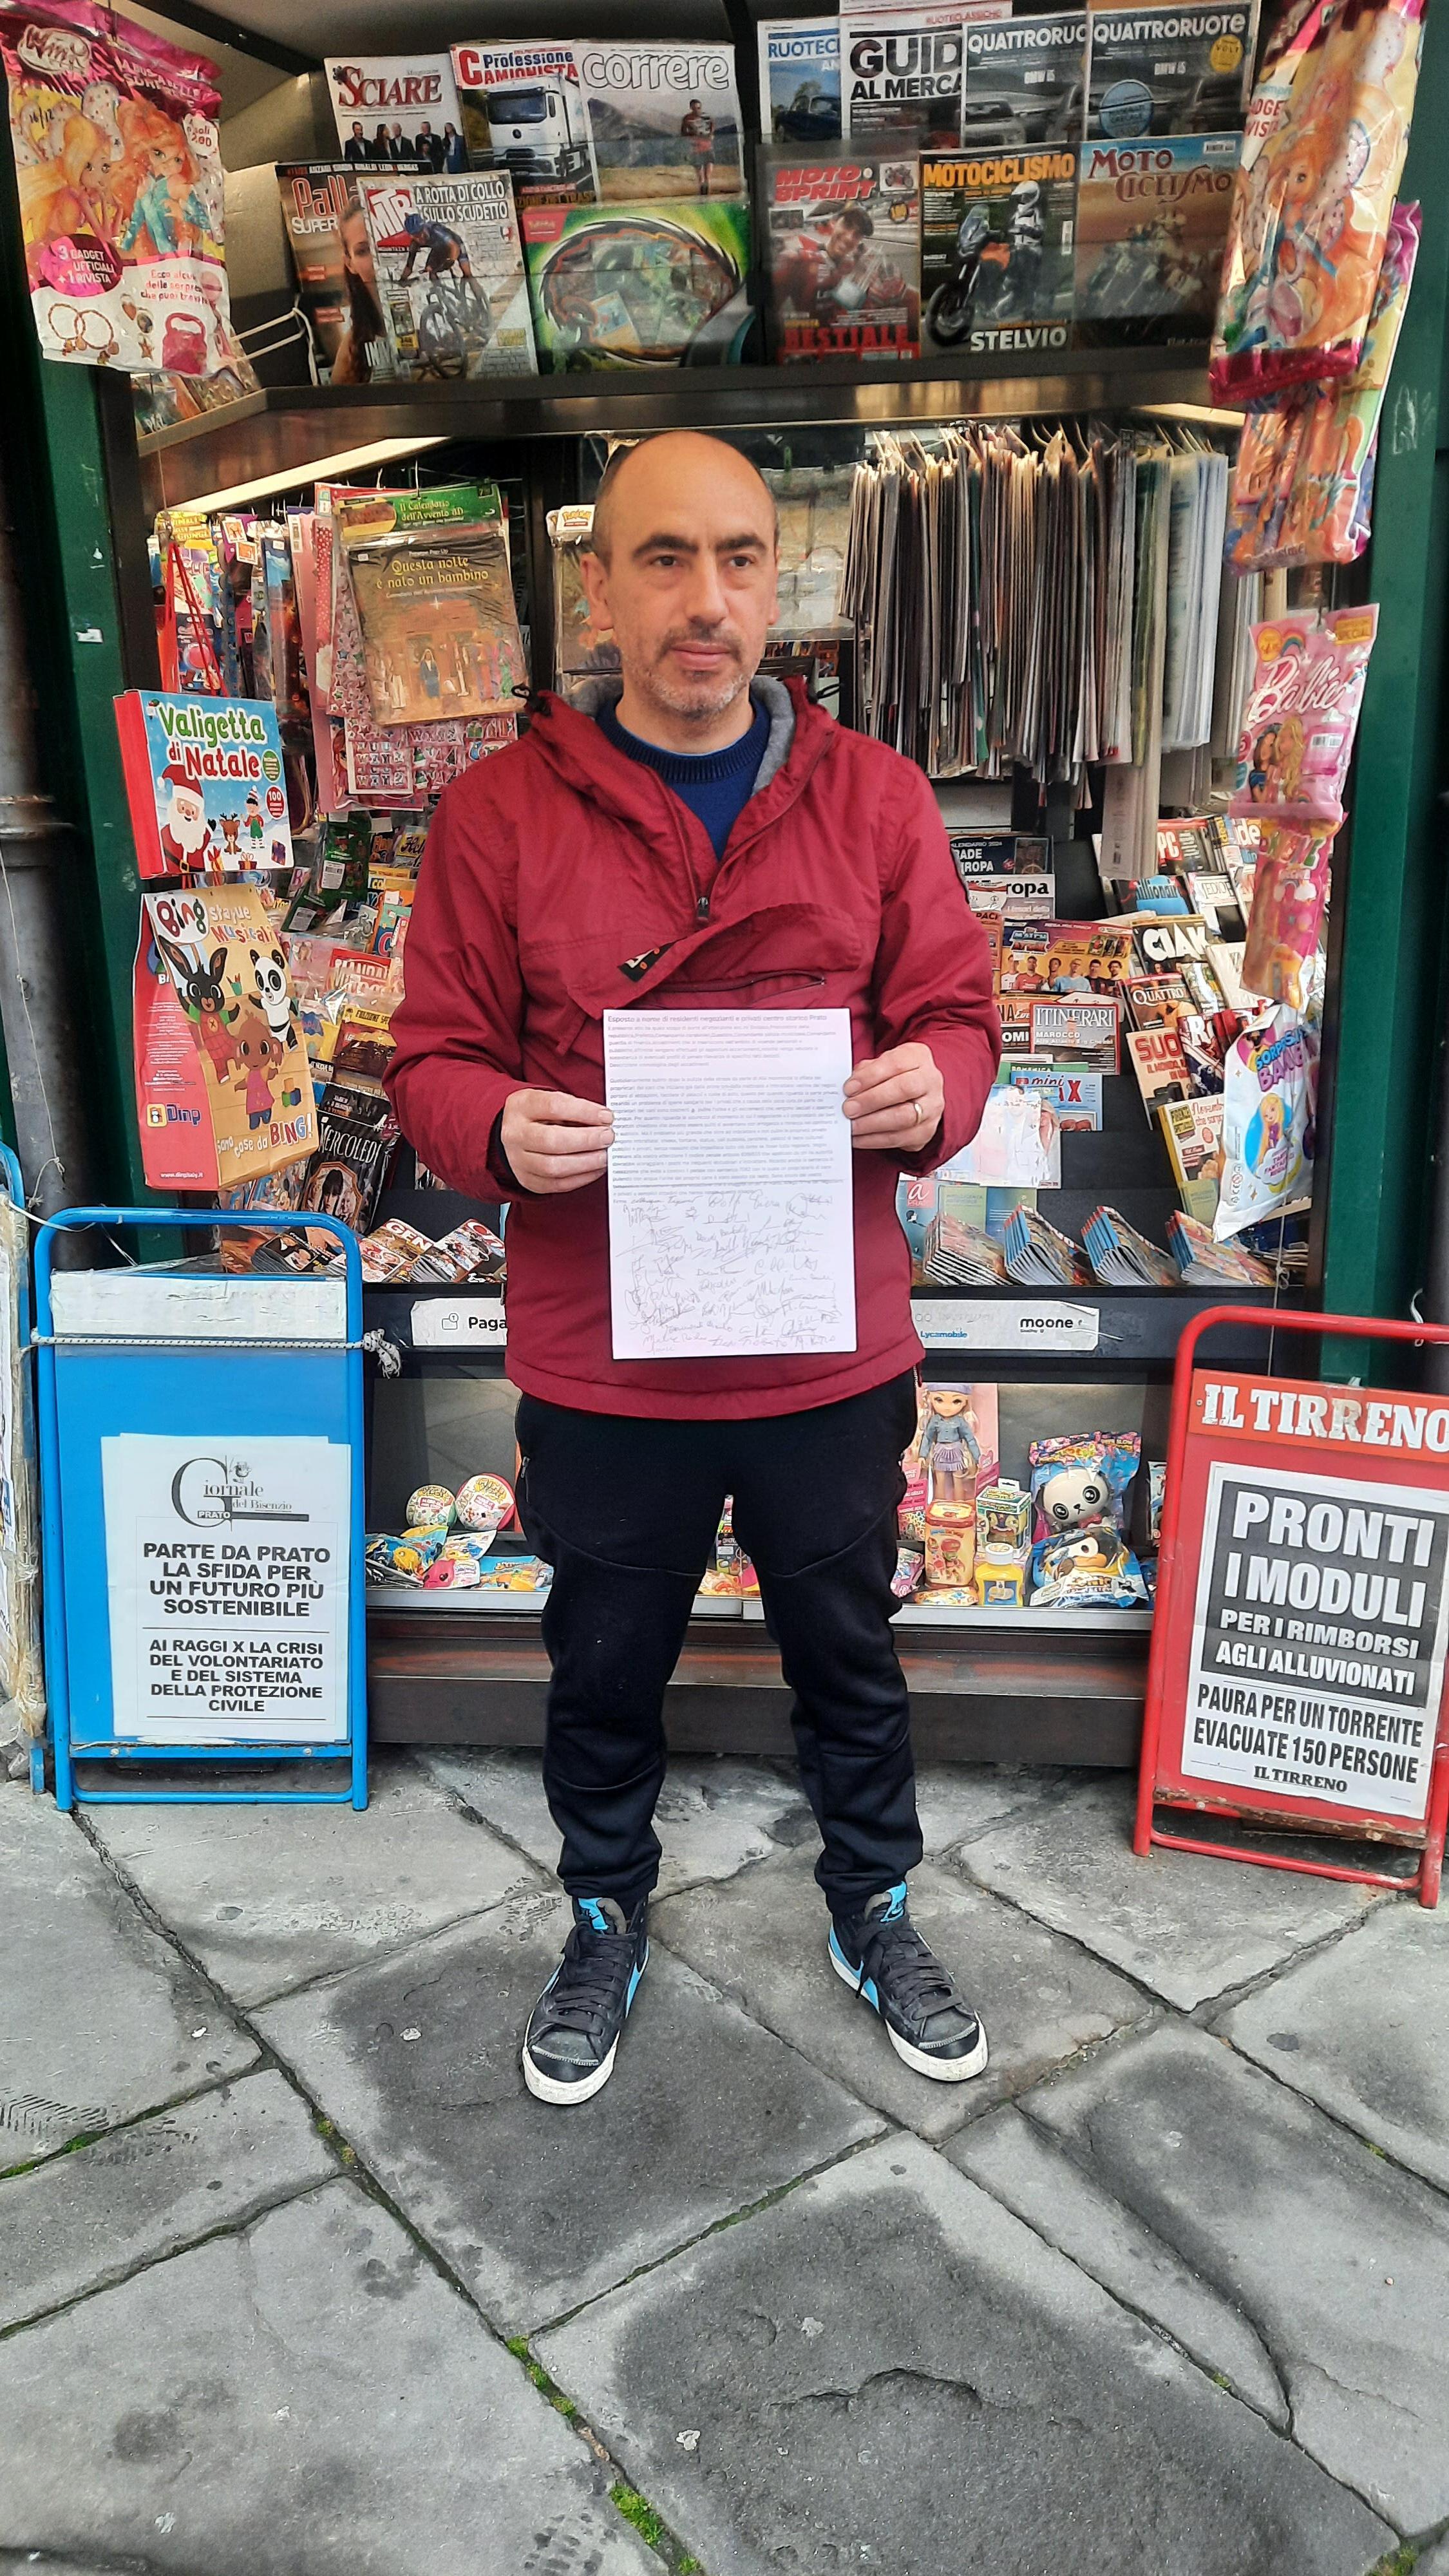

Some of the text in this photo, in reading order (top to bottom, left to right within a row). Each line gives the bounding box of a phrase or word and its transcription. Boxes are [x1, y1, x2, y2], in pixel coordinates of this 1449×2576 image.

[483, 52, 573, 68] Professione
[582, 53, 729, 91] correre
[338, 66, 443, 108] SCIARE
[851, 80, 881, 100] AL
[775, 165, 861, 186] MOTO
[923, 153, 1075, 187] MOTOCICLISMO
[416, 187, 423, 204] A
[424, 185, 456, 204] ROTTA
[458, 184, 471, 202] DI
[472, 180, 506, 200] COLLO
[775, 180, 876, 203] SPRINT
[422, 202, 509, 224] SULLO SCUDETTO
[57, 245, 104, 261] 3 GADGET
[969, 326, 1067, 352] STELVIO
[392, 556, 469, 576] Questa notte
[388, 576, 415, 589] nato
[419, 574, 434, 586] un
[437, 569, 489, 584] bambino
[158, 705, 265, 748] Valigetta
[168, 743, 182, 761] di
[184, 746, 261, 779] Natale
[268, 791, 281, 801] 100
[156, 898, 206, 938] Bing
[210, 922, 274, 944] Musicali
[1036, 1007, 1113, 1028] ITINERARI
[1031, 1074, 1065, 1087] mini
[269, 1112, 313, 1148] BING!
[234, 1139, 254, 1159] cose
[257, 1135, 269, 1151] da
[468, 1316, 508, 1332] Paga
[1201, 1383, 1449, 1453] IL TIRRENO
[171, 1457, 264, 1531] Giornale
[232, 1499, 247, 1509] del
[197, 1510, 231, 1519] PRATO
[1231, 1490, 1435, 1567] PRONTI
[143, 1543, 330, 1564] PARTE DA PRATO
[162, 1562, 312, 1581] LA SFIDA PER
[149, 1580, 325, 1599] UN FUTURO PIÙ
[1224, 1551, 1426, 1628] I MODULI
[163, 1599, 310, 1617] SOSTENIBILE
[1220, 1608, 1420, 1660] PER I RIMBORSI
[149, 1640, 323, 1655] AI RAGGI X LA CRISI
[149, 1654, 323, 1669] DEL VOLONTARIATO
[1215, 1640, 1416, 1696] AGLI ALLUVIONATI
[171, 1669, 303, 1684] E DEL SISTEMA
[151, 1684, 323, 1699] DELLA PROTEZIONE
[208, 1699, 265, 1712] CIVILE
[1197, 1683, 1425, 1748] PAURA PER UN TORRENTE
[1193, 1717, 1419, 1784] EVACUATE 150 PERSONE
[1254, 1765, 1349, 1793] IL TIRRENO
